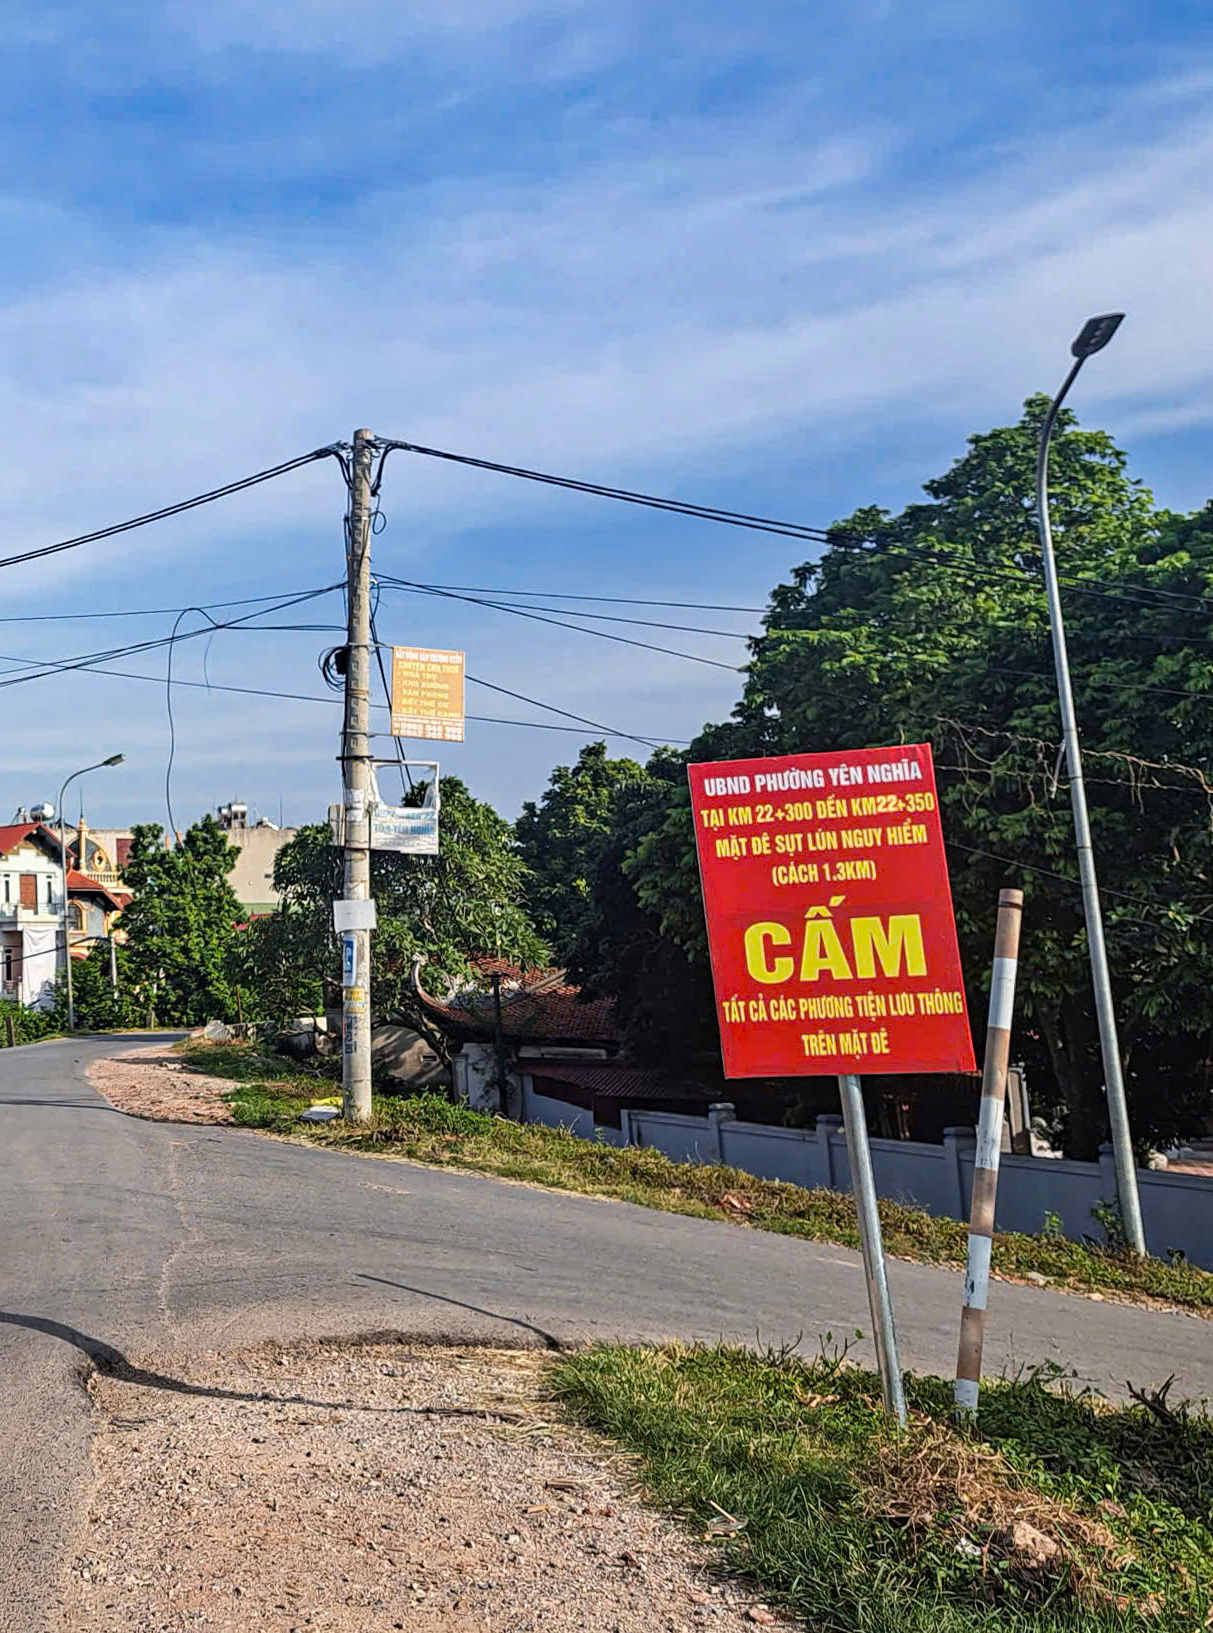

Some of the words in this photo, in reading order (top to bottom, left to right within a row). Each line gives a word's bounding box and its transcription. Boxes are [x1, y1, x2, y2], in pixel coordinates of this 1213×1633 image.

[704, 776, 750, 797] UBND
[755, 768, 824, 793] PHƯỜNG
[829, 764, 863, 786] YÊN
[867, 758, 922, 783] NGHĨA
[701, 809, 725, 831] TẠI
[728, 806, 752, 826] KM
[755, 801, 813, 824] 22+300
[816, 794, 848, 819] ĐẾN
[715, 837, 747, 861] MẶT
[751, 834, 771, 855] ĐÊ
[775, 832, 803, 856] SỤT
[808, 828, 838, 851] LÚN
[841, 828, 882, 848] NGUY
[888, 818, 927, 846] HIỂM
[772, 861, 819, 886] (CÁCH
[822, 860, 876, 881] 1.3KM)
[744, 895, 928, 985] CẤM
[723, 994, 747, 1023] TẤT
[748, 993, 769, 1022] CẢ
[770, 994, 796, 1021] CÁC
[799, 994, 854, 1019] PHƯƠNG
[855, 991, 887, 1021] TIỆN
[917, 988, 964, 1015] THÔNG
[801, 1029, 837, 1056] TRÊN
[839, 1029, 868, 1059] MẶT
[871, 1028, 890, 1054] ĐÊ
